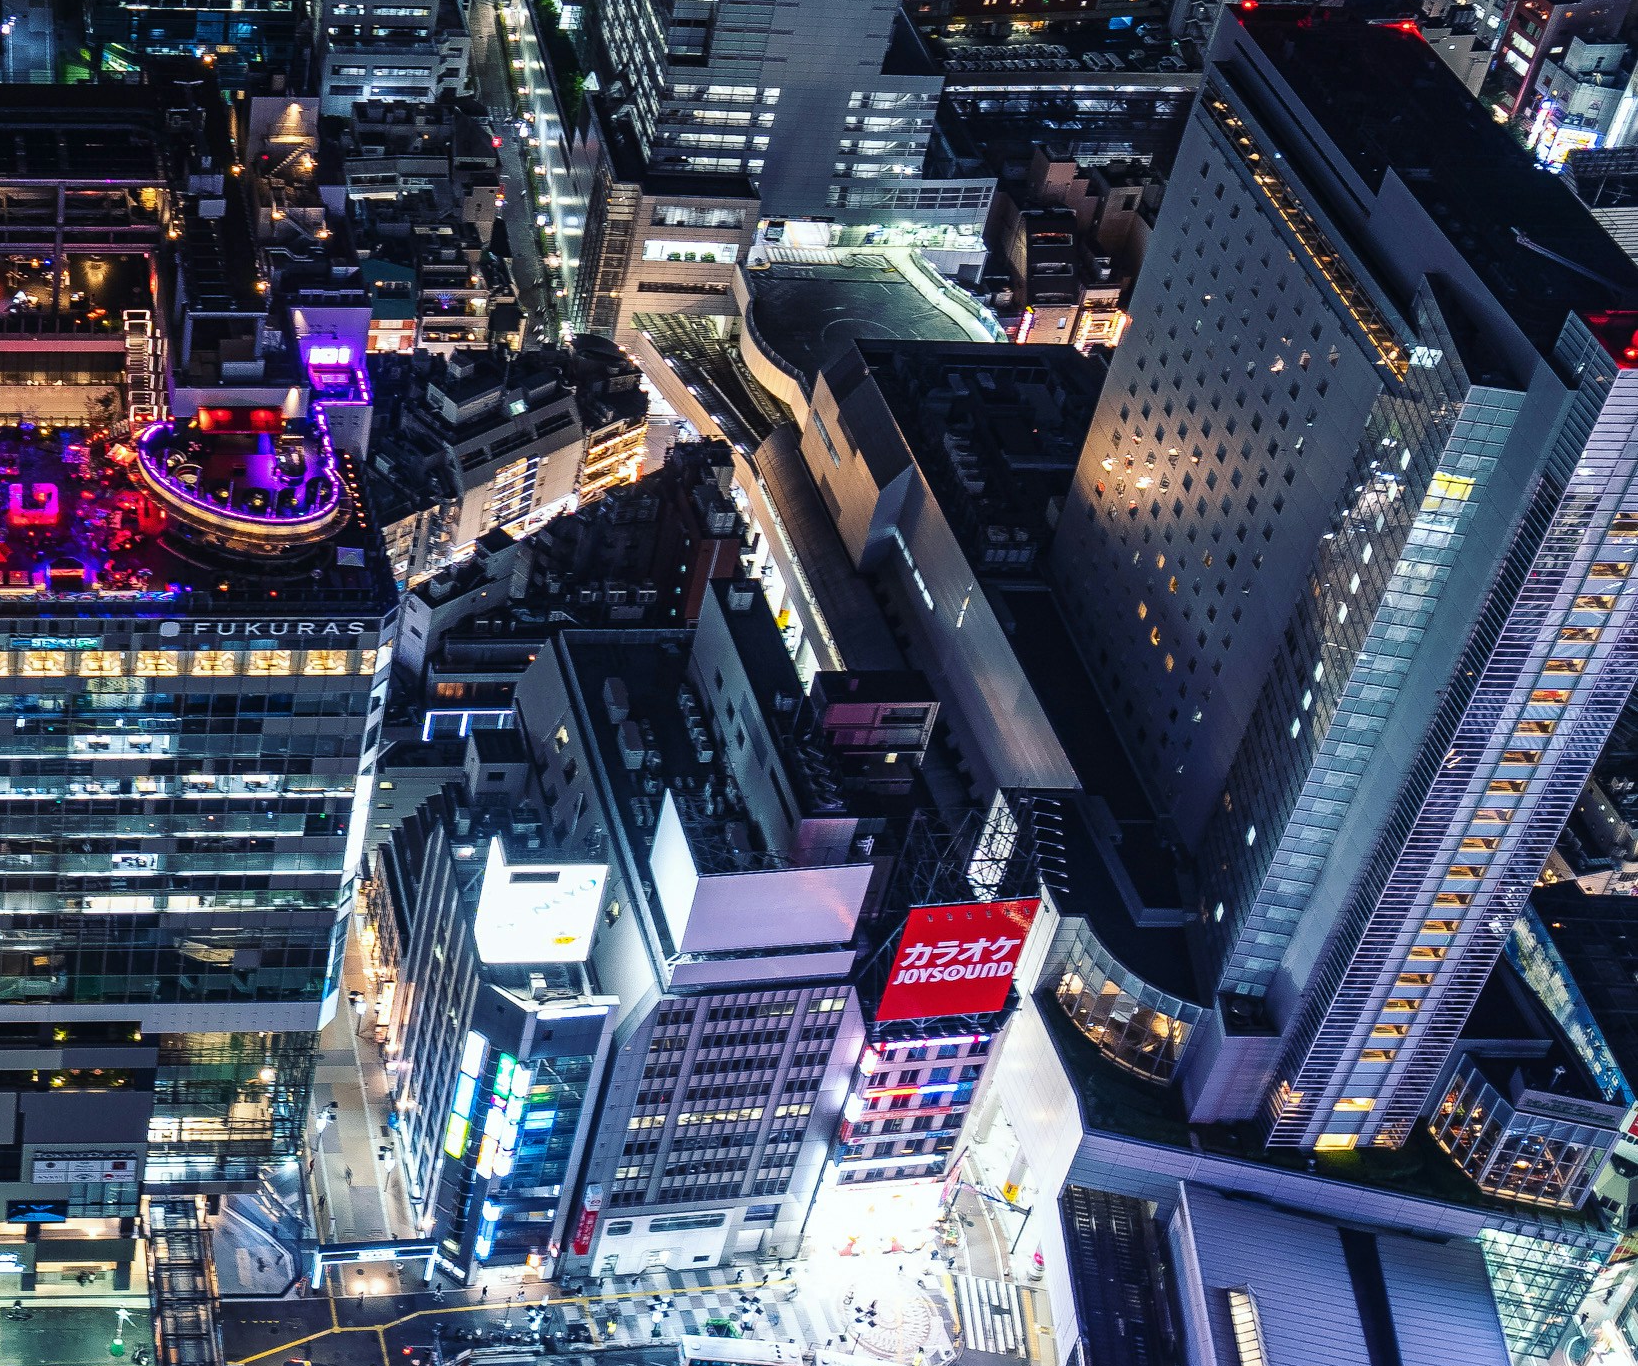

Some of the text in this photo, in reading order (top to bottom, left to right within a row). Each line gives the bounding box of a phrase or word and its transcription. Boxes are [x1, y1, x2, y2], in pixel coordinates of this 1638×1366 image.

[193, 621, 365, 637] FUKURAS
[900, 936, 1022, 968] カラオケ
[892, 961, 1015, 985] JOYSOUND
